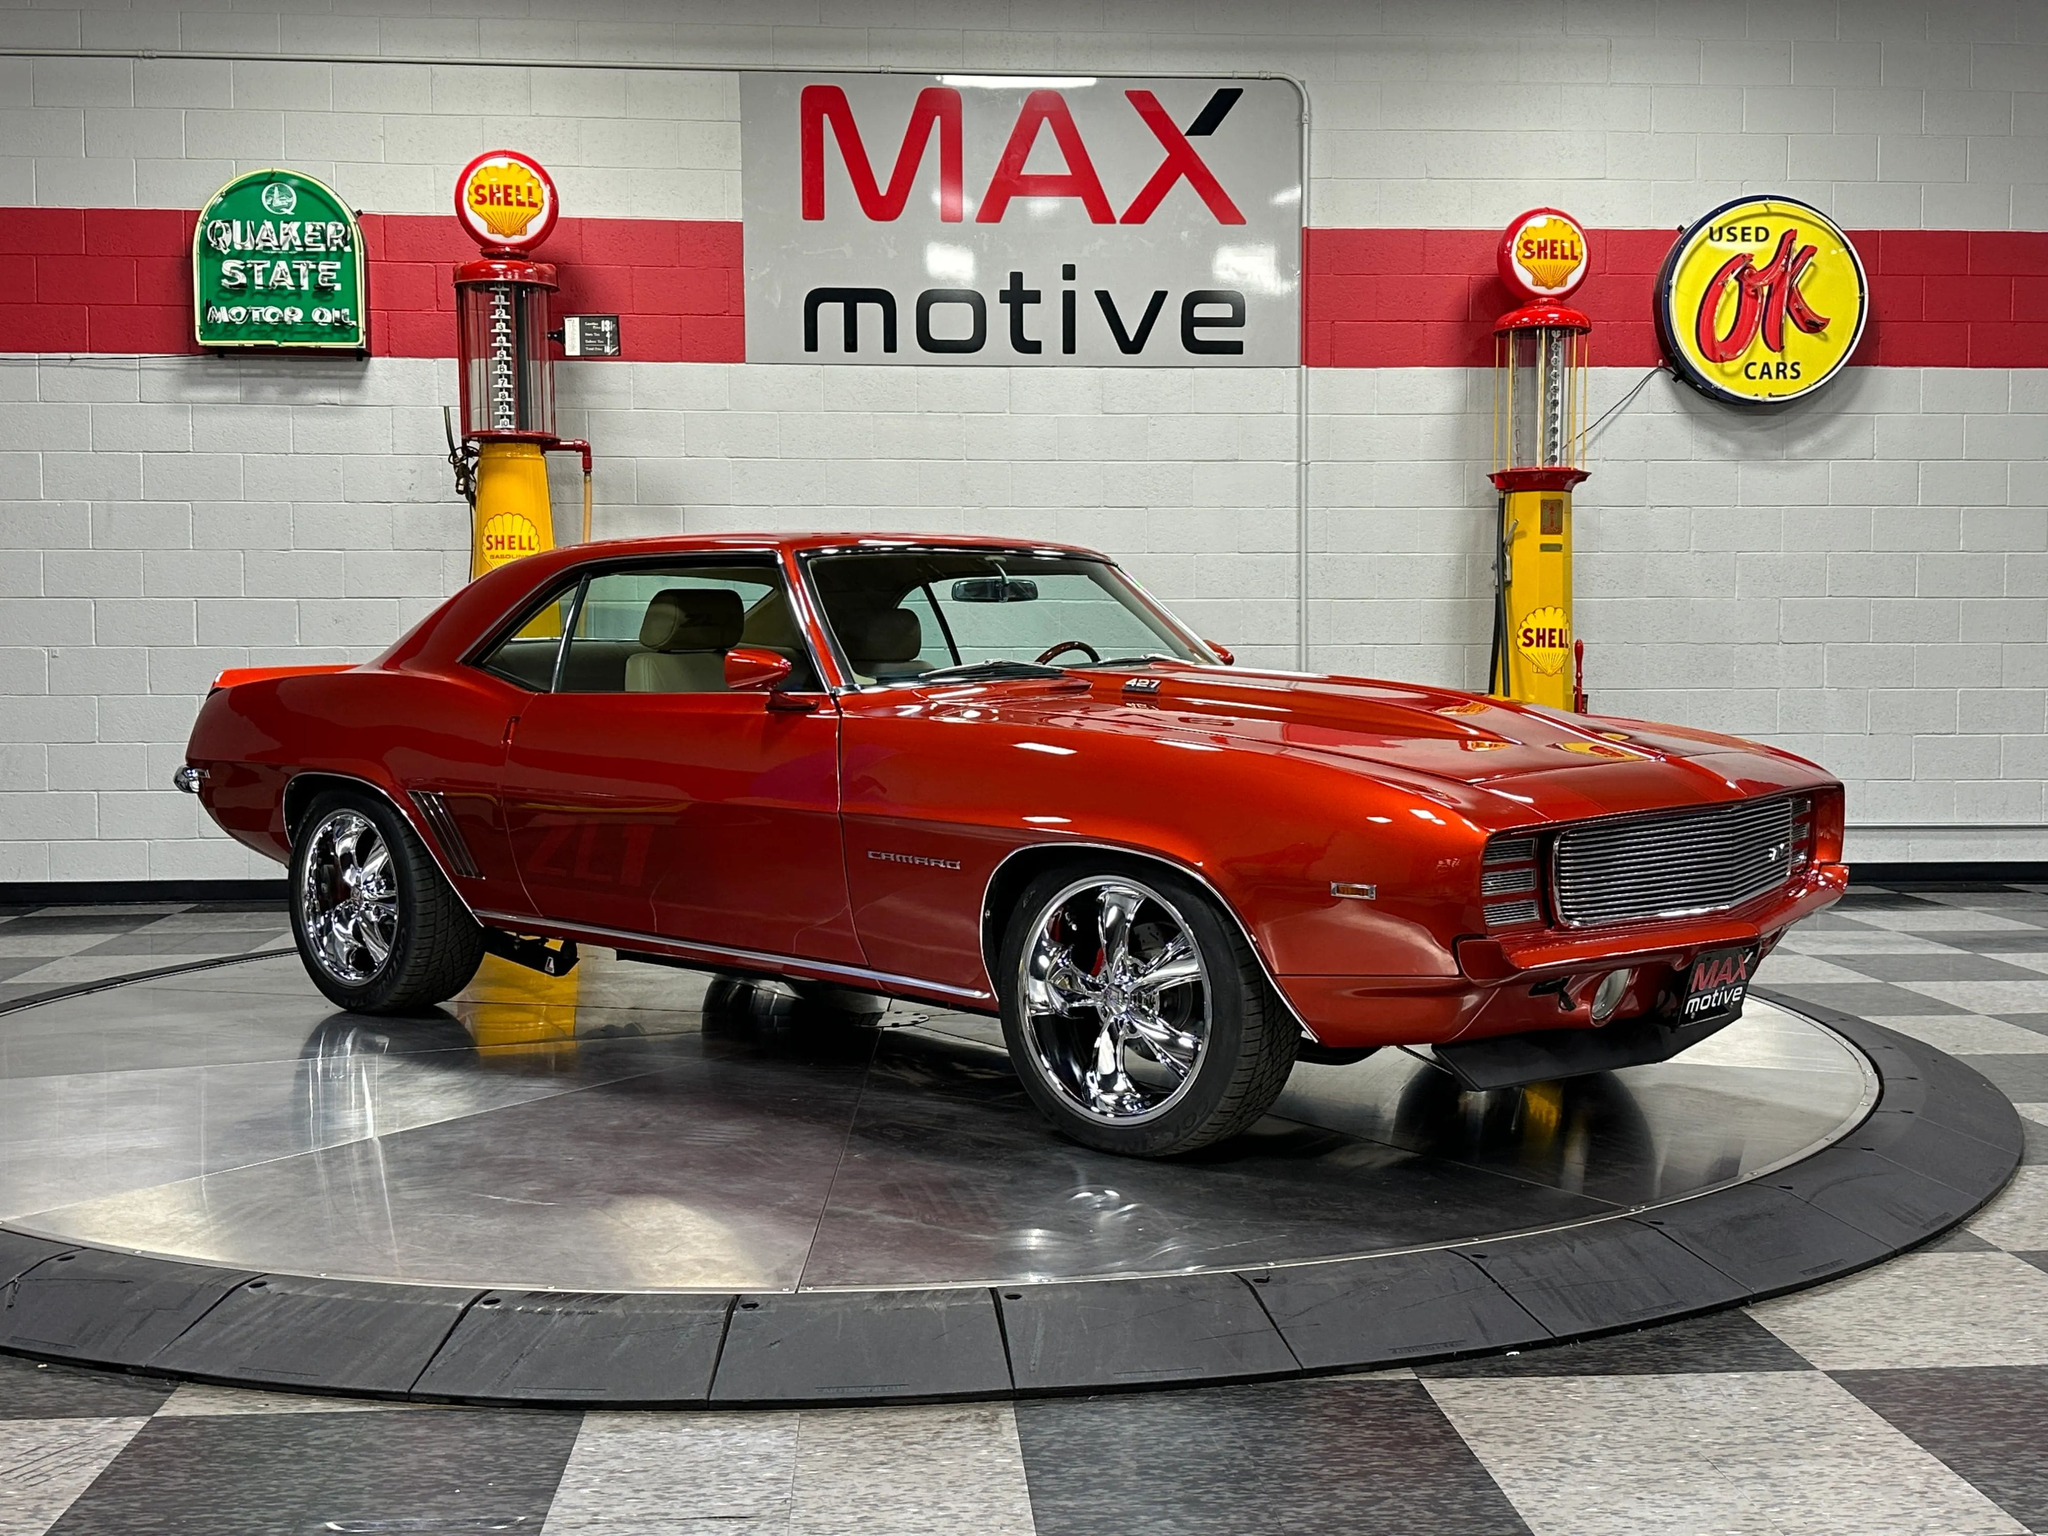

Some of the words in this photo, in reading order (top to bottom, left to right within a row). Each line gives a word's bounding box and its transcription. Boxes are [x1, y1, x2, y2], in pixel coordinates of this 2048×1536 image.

[800, 85, 1247, 225] MAX
[474, 184, 538, 208] SHELL
[207, 219, 352, 255] QUAKER
[1708, 226, 1770, 243] USED
[1522, 239, 1579, 261] SHELL
[221, 259, 341, 291] STATE
[207, 306, 304, 325] MOTOR
[311, 306, 356, 326] OIL
[803, 264, 1246, 355] motive
[1744, 362, 1801, 380] CARS
[486, 534, 535, 550] SHELL
[1522, 628, 1568, 648] SHELL
[1125, 678, 1161, 688] 427
[867, 850, 961, 870] CAMARO
[1690, 952, 1754, 993] MAX
[1684, 985, 1743, 1015] motive
